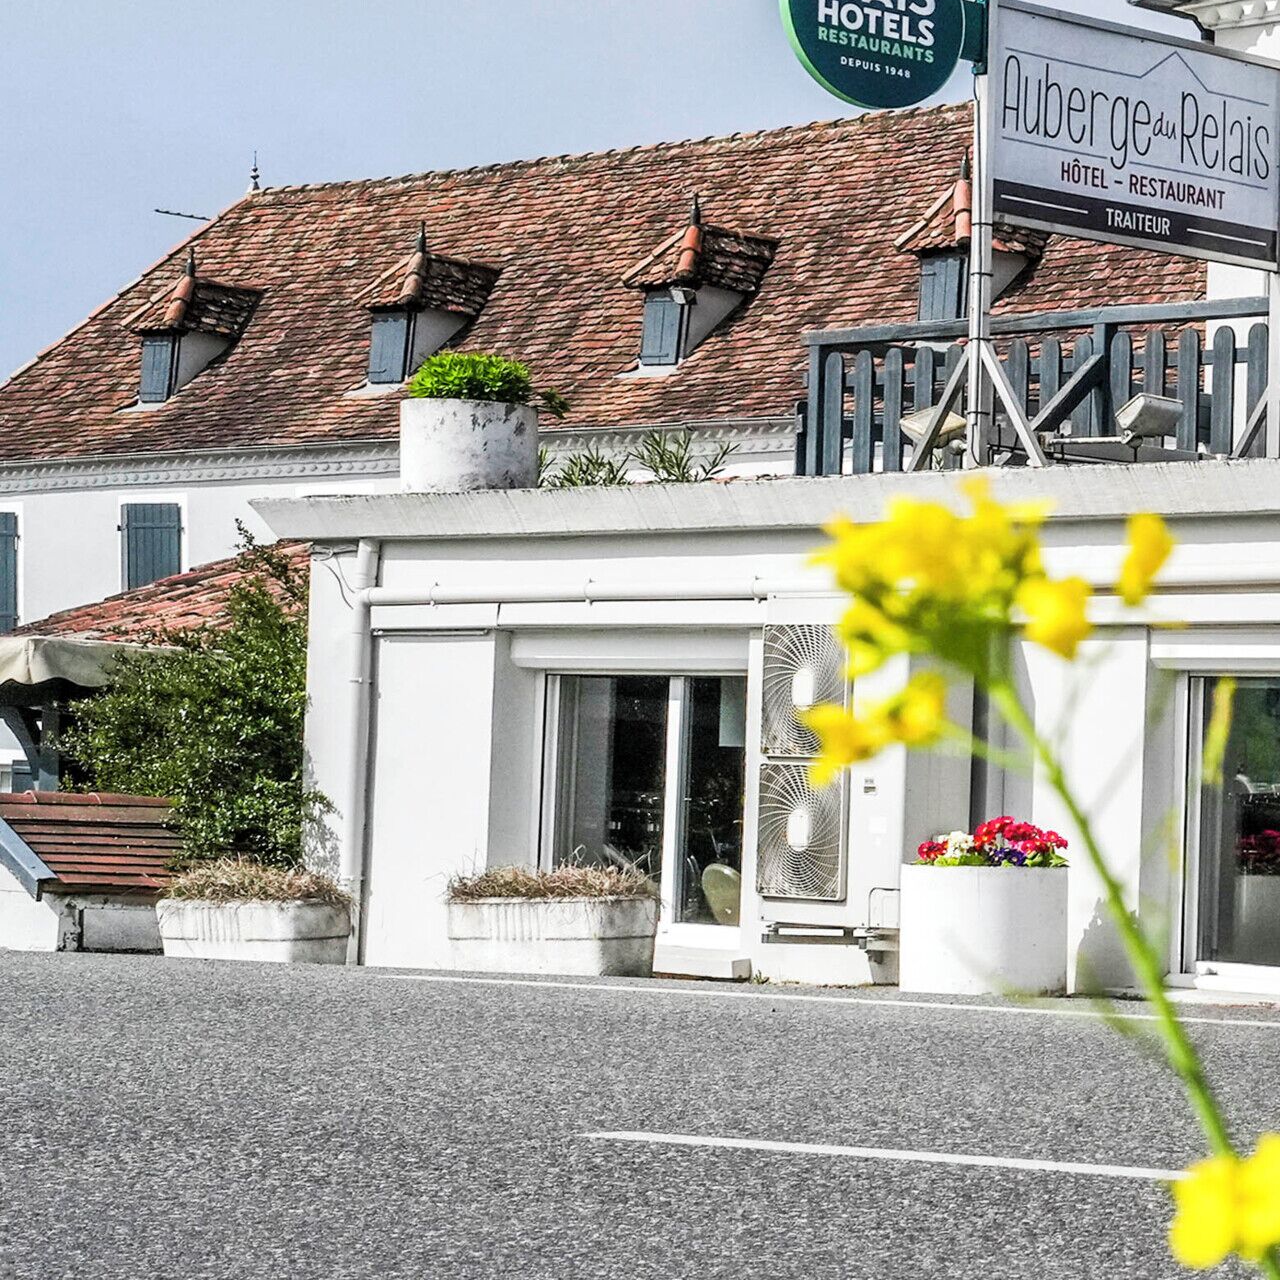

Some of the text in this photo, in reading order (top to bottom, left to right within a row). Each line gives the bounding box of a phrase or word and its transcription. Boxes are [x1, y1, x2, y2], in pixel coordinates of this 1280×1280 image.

[818, 26, 934, 64] RESTAURANTS
[840, 56, 911, 79] DEPUIS 1948
[1002, 55, 1270, 180] Auberge du Relais
[1061, 157, 1109, 190] HÔTEL
[1128, 174, 1226, 210] RESTAURANT
[1105, 208, 1171, 236] TRAITEUR
